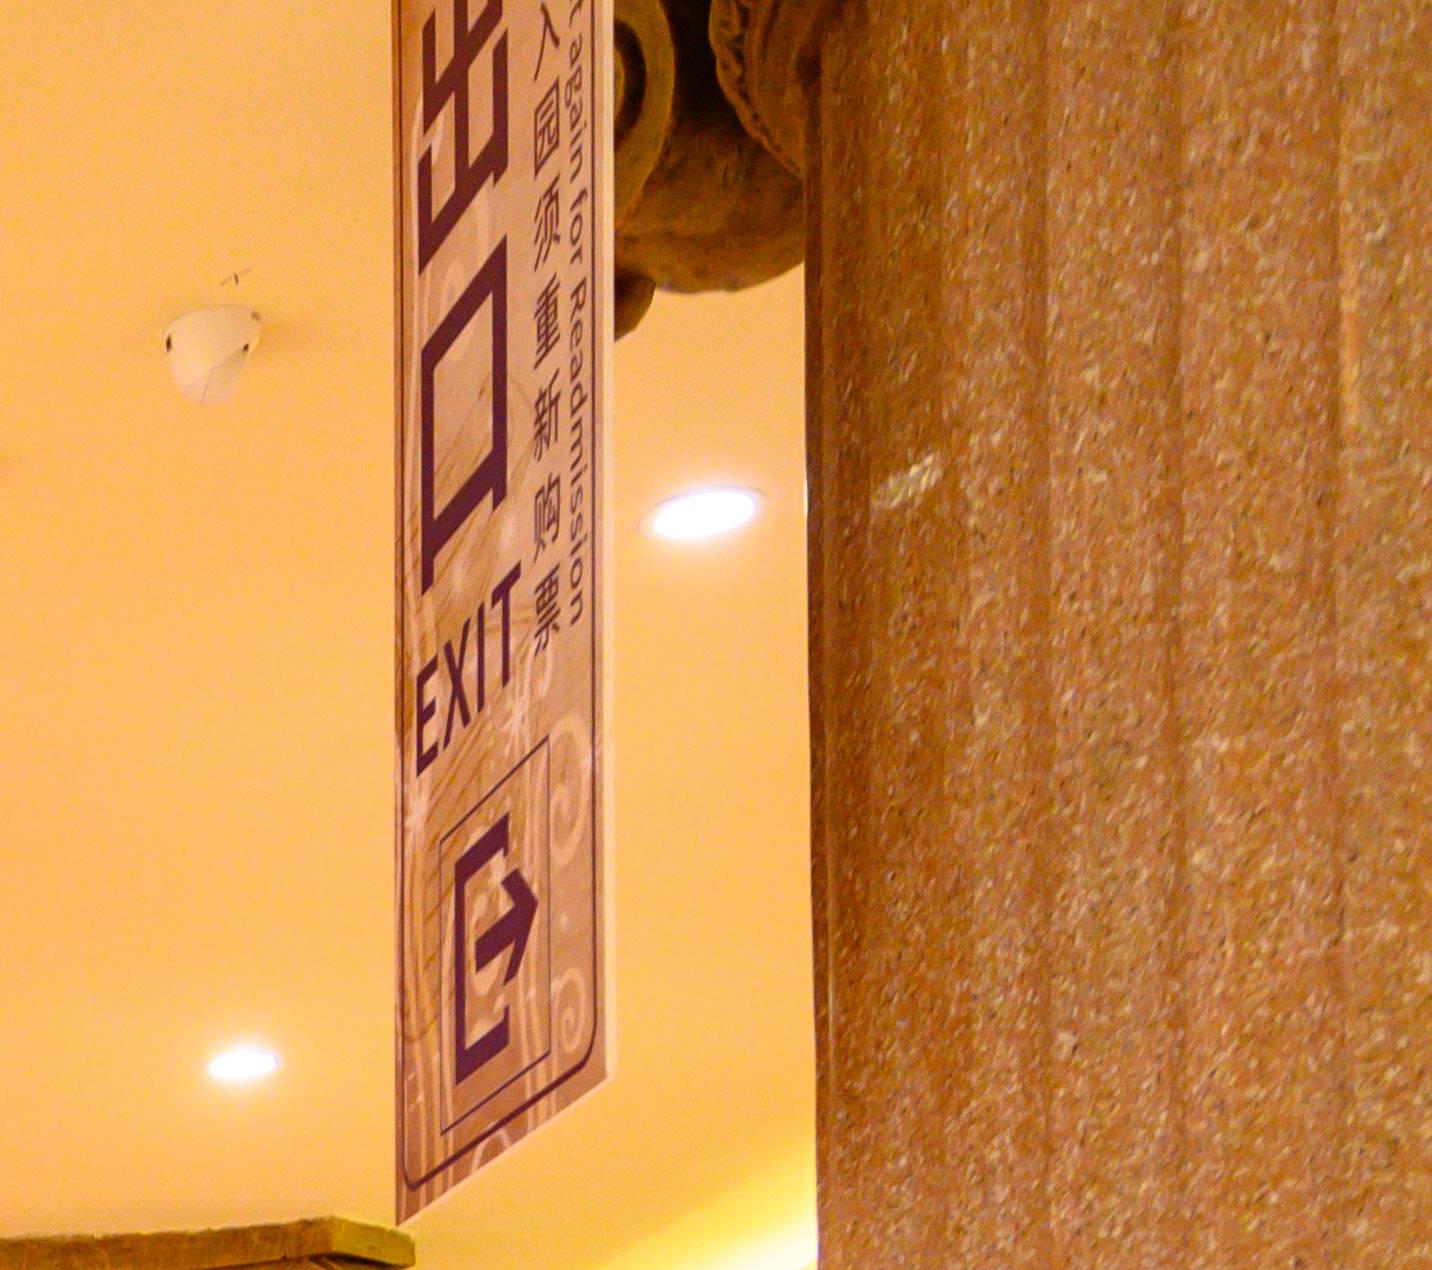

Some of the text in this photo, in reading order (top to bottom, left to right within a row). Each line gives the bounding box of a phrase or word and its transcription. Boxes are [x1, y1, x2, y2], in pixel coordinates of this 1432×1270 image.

[565, 34, 588, 184] again
[418, 0, 508, 596] 出口
[570, 187, 588, 265] for
[570, 276, 588, 625] Readmission
[416, 560, 521, 777] EXIT
